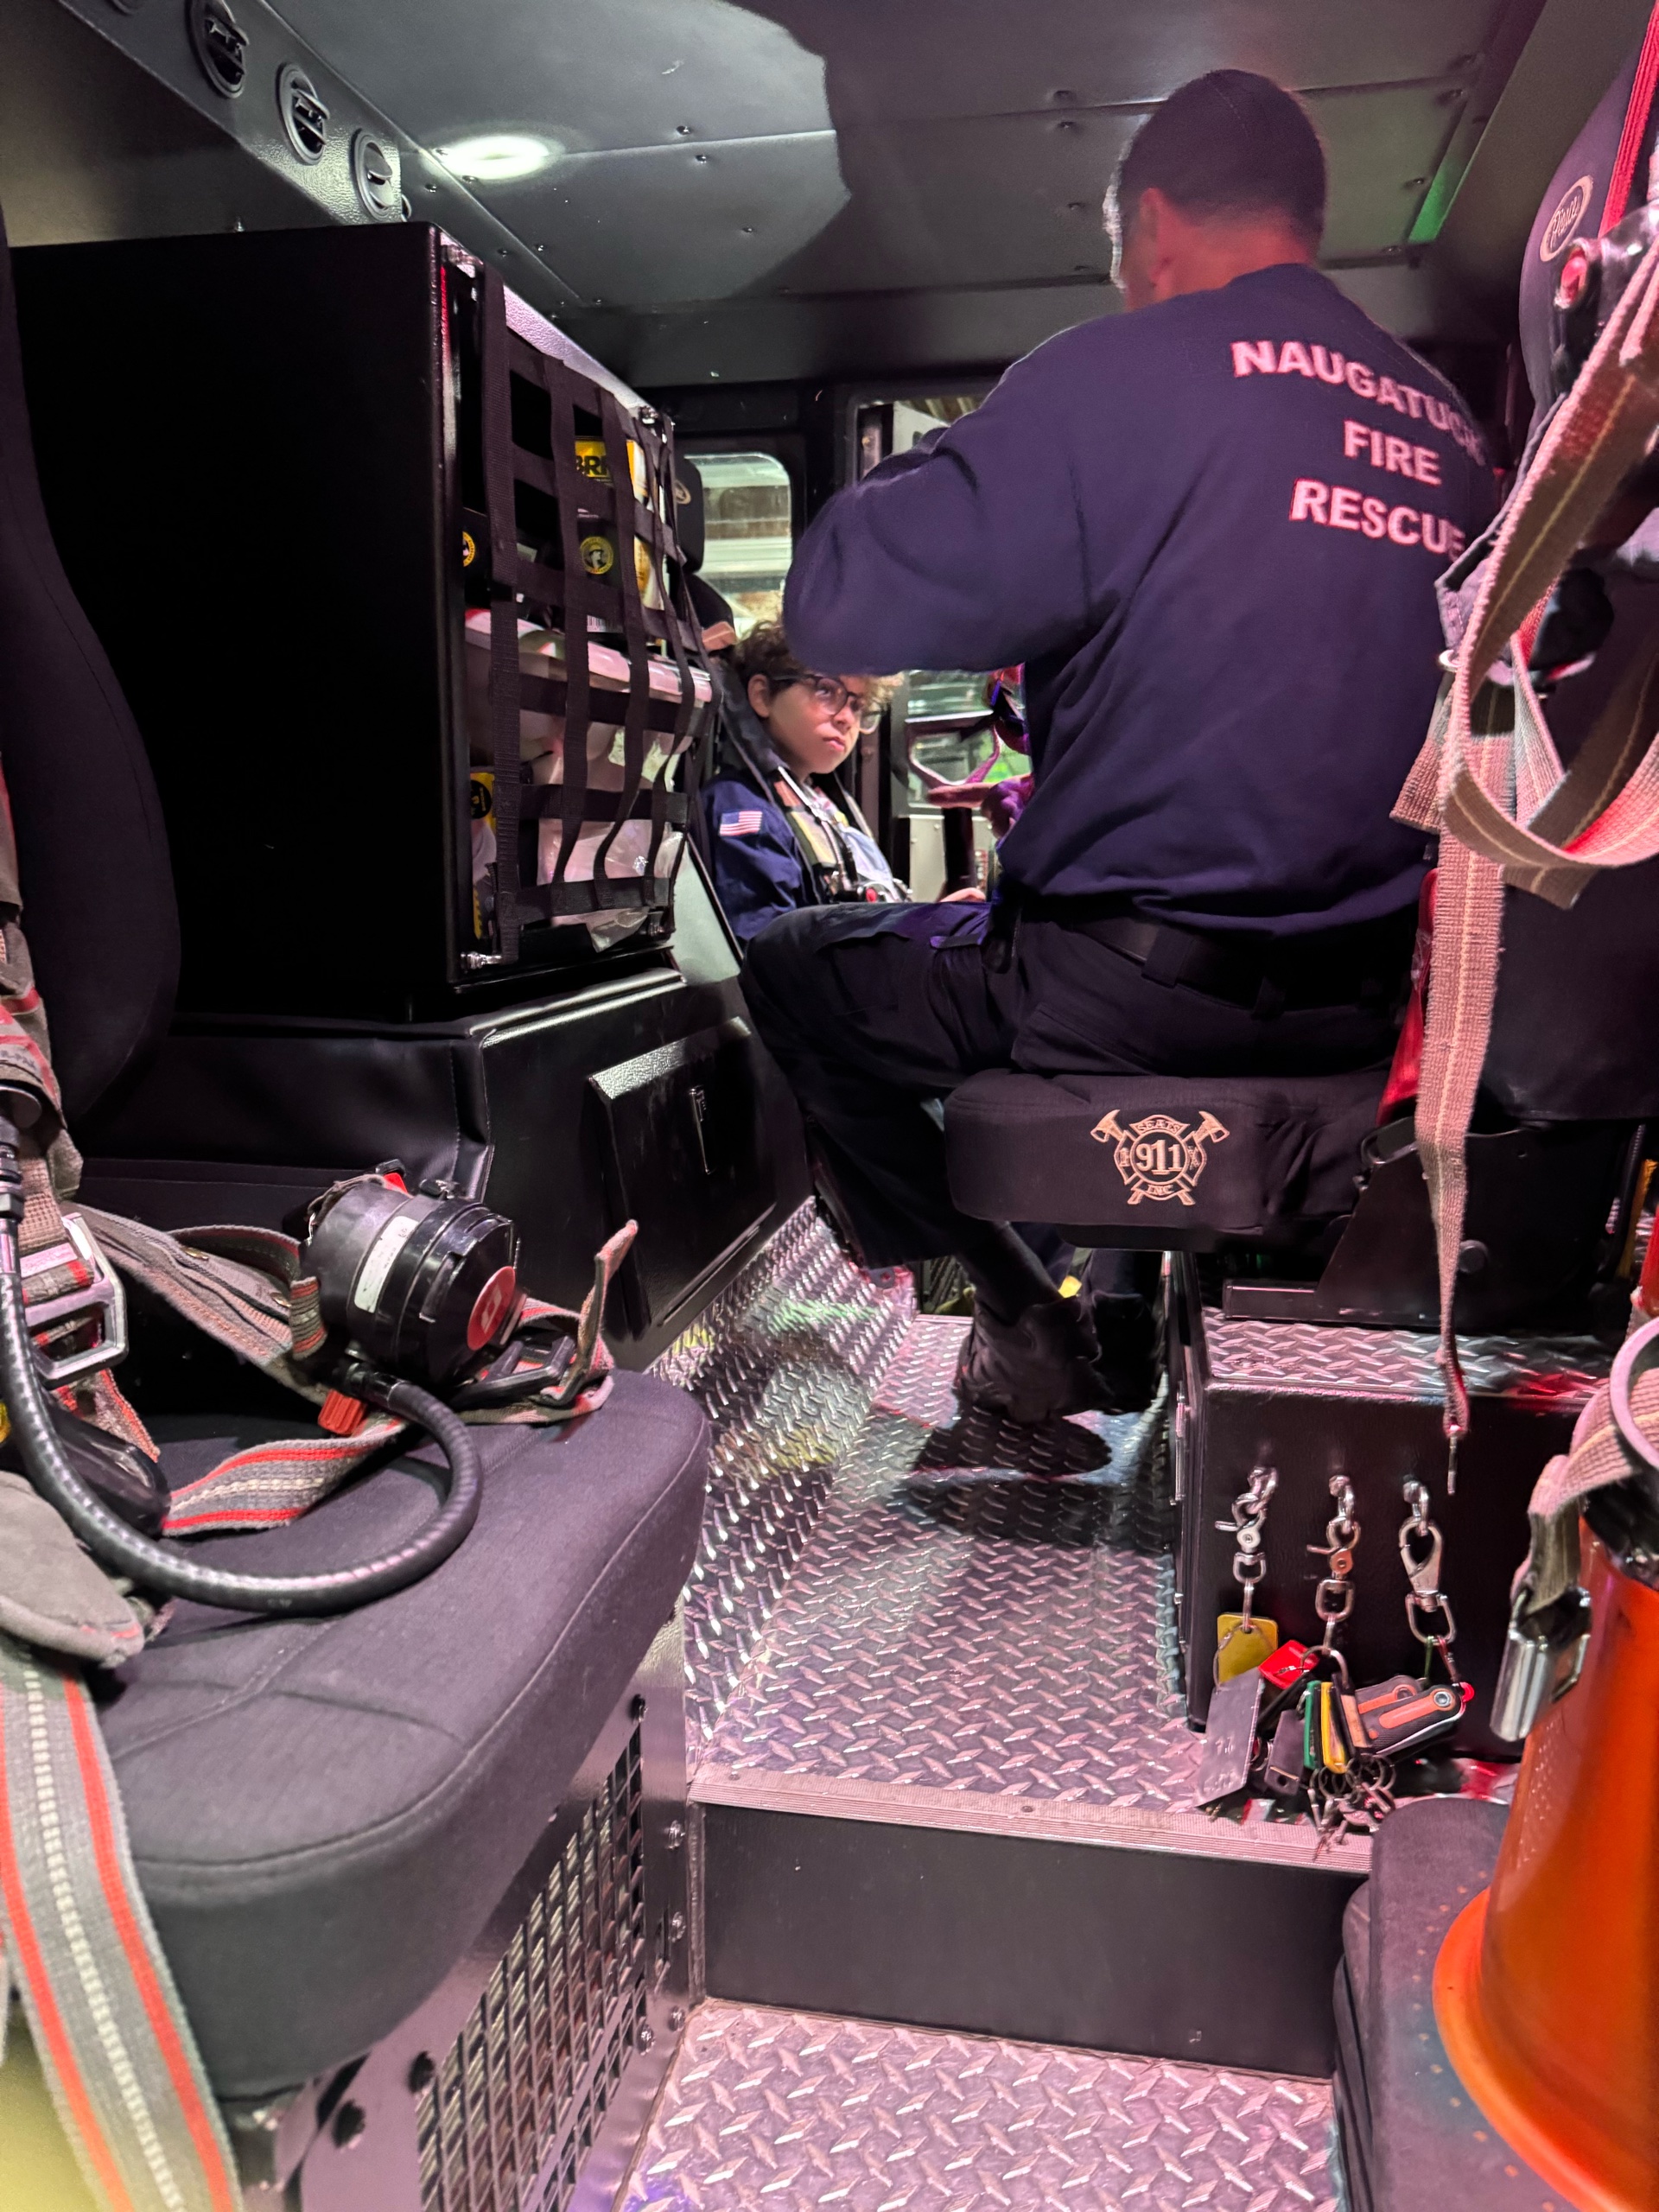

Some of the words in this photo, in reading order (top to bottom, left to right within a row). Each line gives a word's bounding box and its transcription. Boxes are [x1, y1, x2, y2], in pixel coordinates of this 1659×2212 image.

[1344, 418, 1442, 487] FIRE
[1288, 477, 1466, 562] RESCUE
[1135, 1139, 1183, 1175] 911
